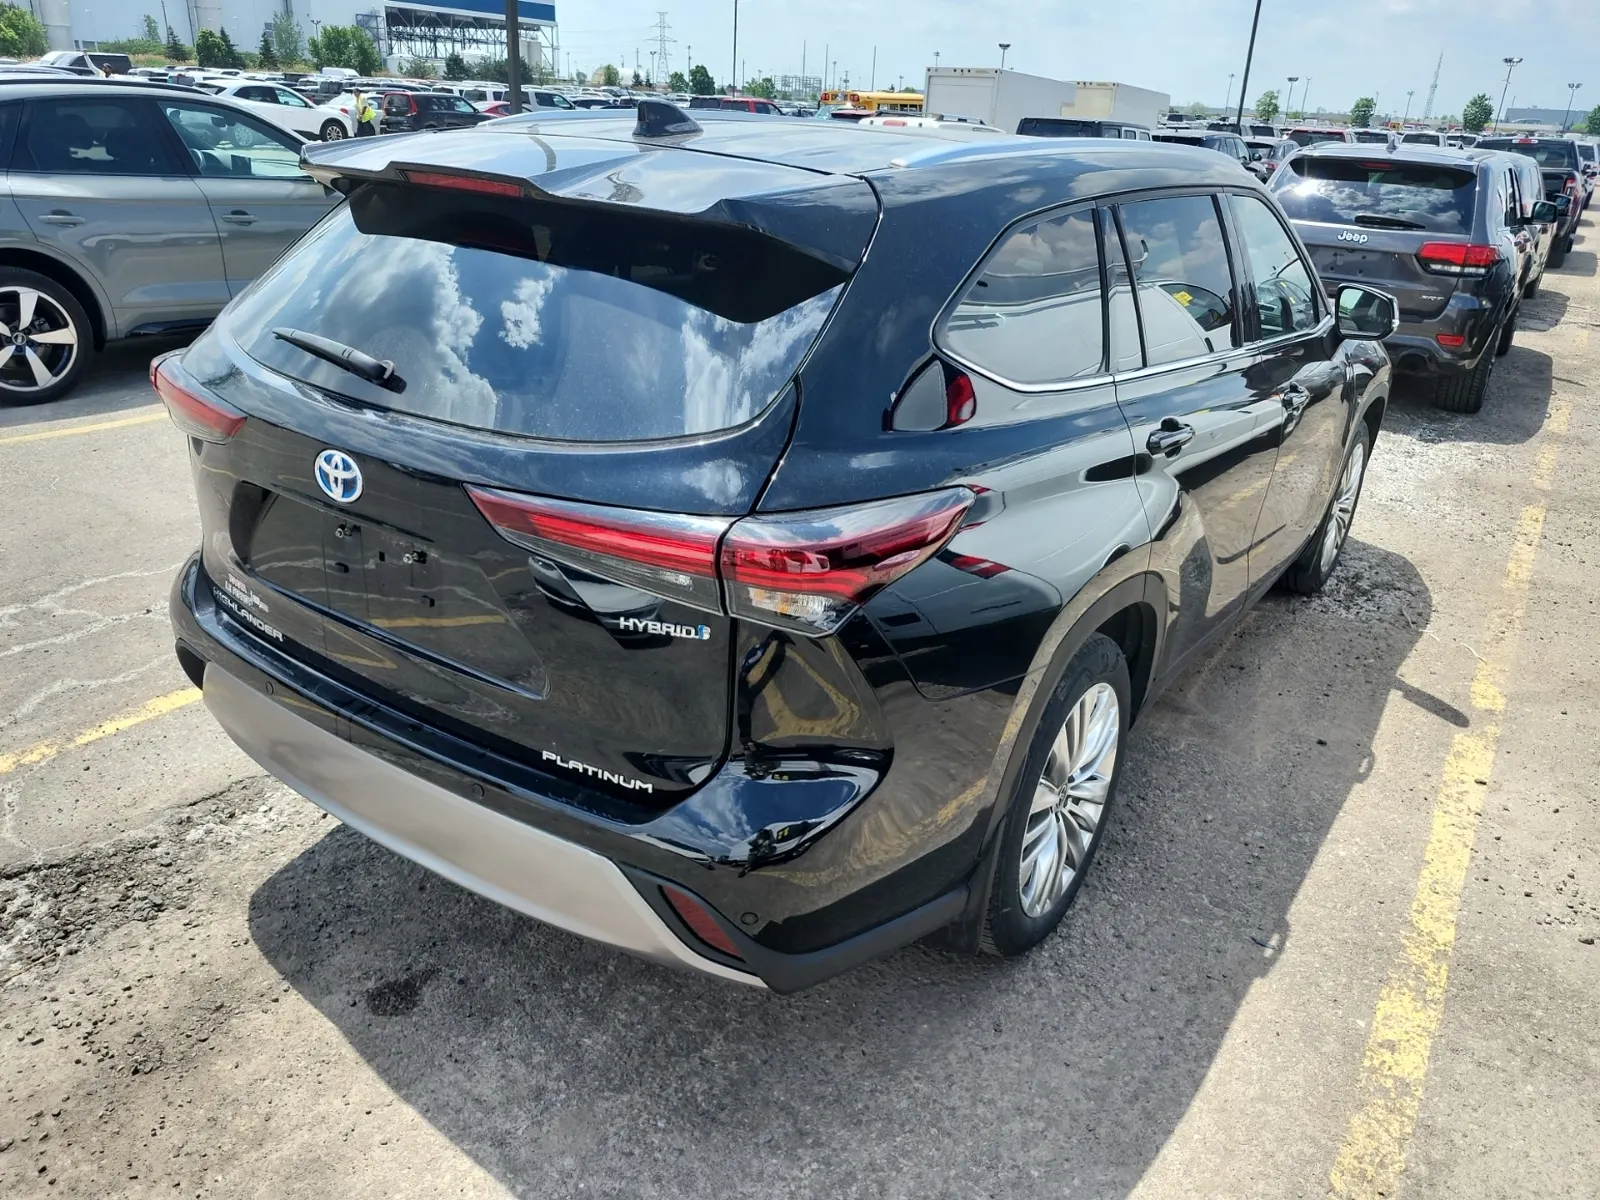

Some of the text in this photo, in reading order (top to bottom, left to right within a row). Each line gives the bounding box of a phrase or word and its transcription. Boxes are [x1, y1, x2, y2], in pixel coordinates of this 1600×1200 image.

[1337, 230, 1369, 245] Jeep
[212, 586, 284, 642] HIGHLANDER
[619, 616, 695, 639] HYBRID
[541, 749, 653, 794] PLATINUM
